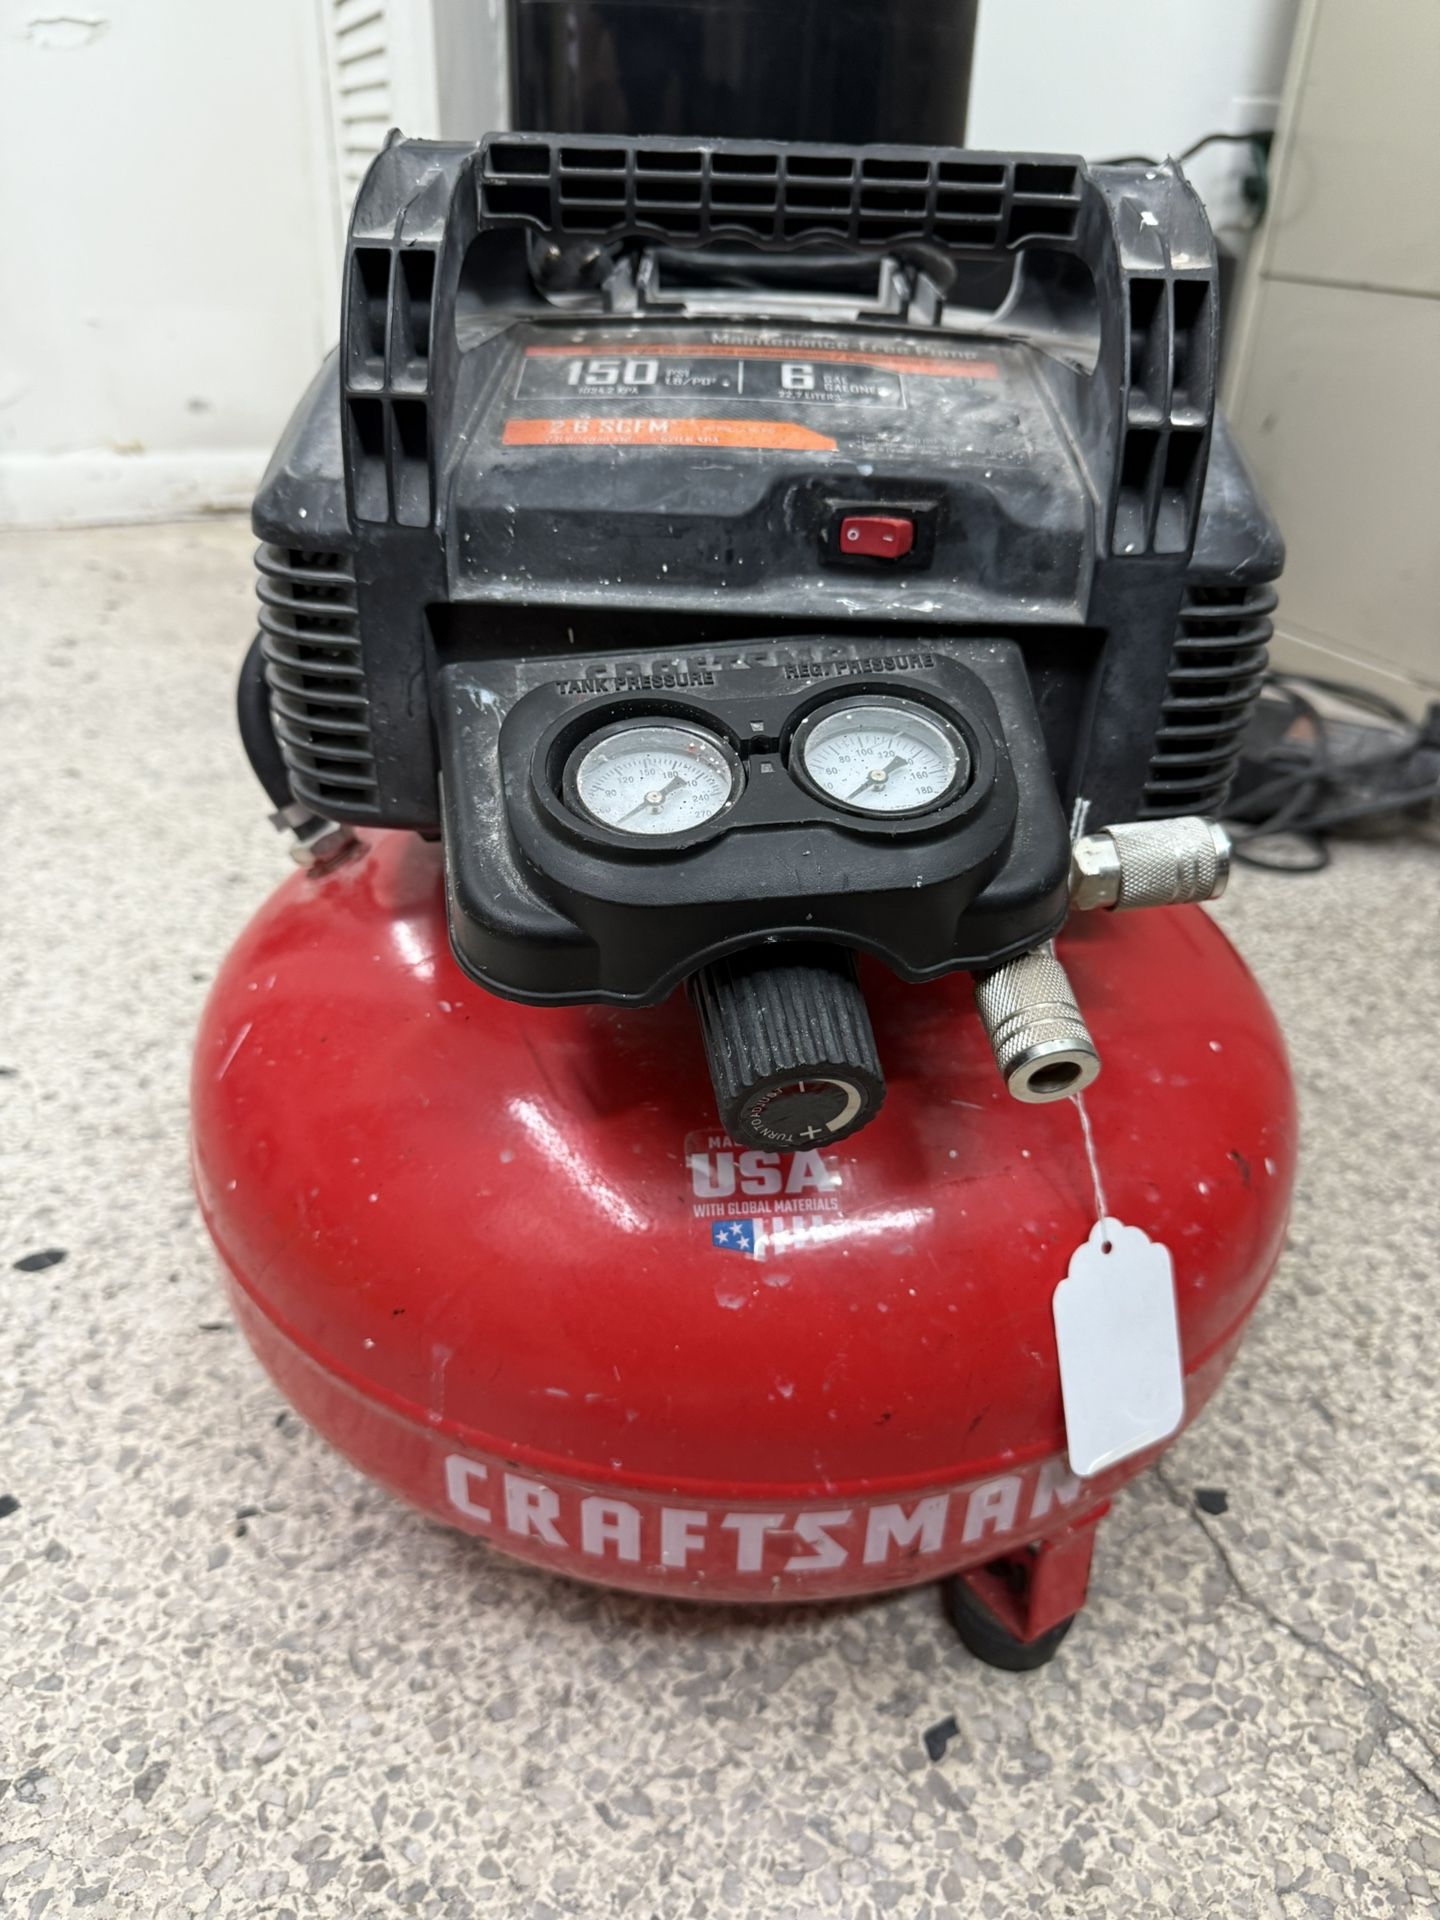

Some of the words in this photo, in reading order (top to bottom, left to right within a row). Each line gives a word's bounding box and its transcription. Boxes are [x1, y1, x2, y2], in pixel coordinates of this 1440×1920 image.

[567, 359, 659, 386] 150
[781, 363, 815, 390] 6
[823, 383, 886, 397] GALONE
[784, 663, 831, 680] REG.
[836, 652, 937, 674] PRESSURE
[556, 679, 609, 696] TANK
[613, 671, 715, 692] PRESSURE
[855, 748, 875, 756] 100
[877, 751, 896, 759] 120
[839, 755, 850, 764] 80
[639, 768, 656, 777] 150
[662, 770, 679, 779] 180
[825, 767, 839, 775] 60
[911, 771, 929, 781] 160
[618, 775, 634, 785] 120
[604, 789, 617, 798] 90
[916, 786, 934, 796] 180
[692, 794, 710, 803] 240
[695, 810, 712, 819] 270
[751, 1118, 764, 1131] TO
[760, 1127, 793, 1142] TURN
[691, 1149, 841, 1198] USA
[693, 1204, 725, 1217] WITH
[728, 1201, 771, 1215] GLOBAL
[774, 1198, 838, 1215] MATERIALS
[445, 1453, 1081, 1572] CRAFTSMAN
